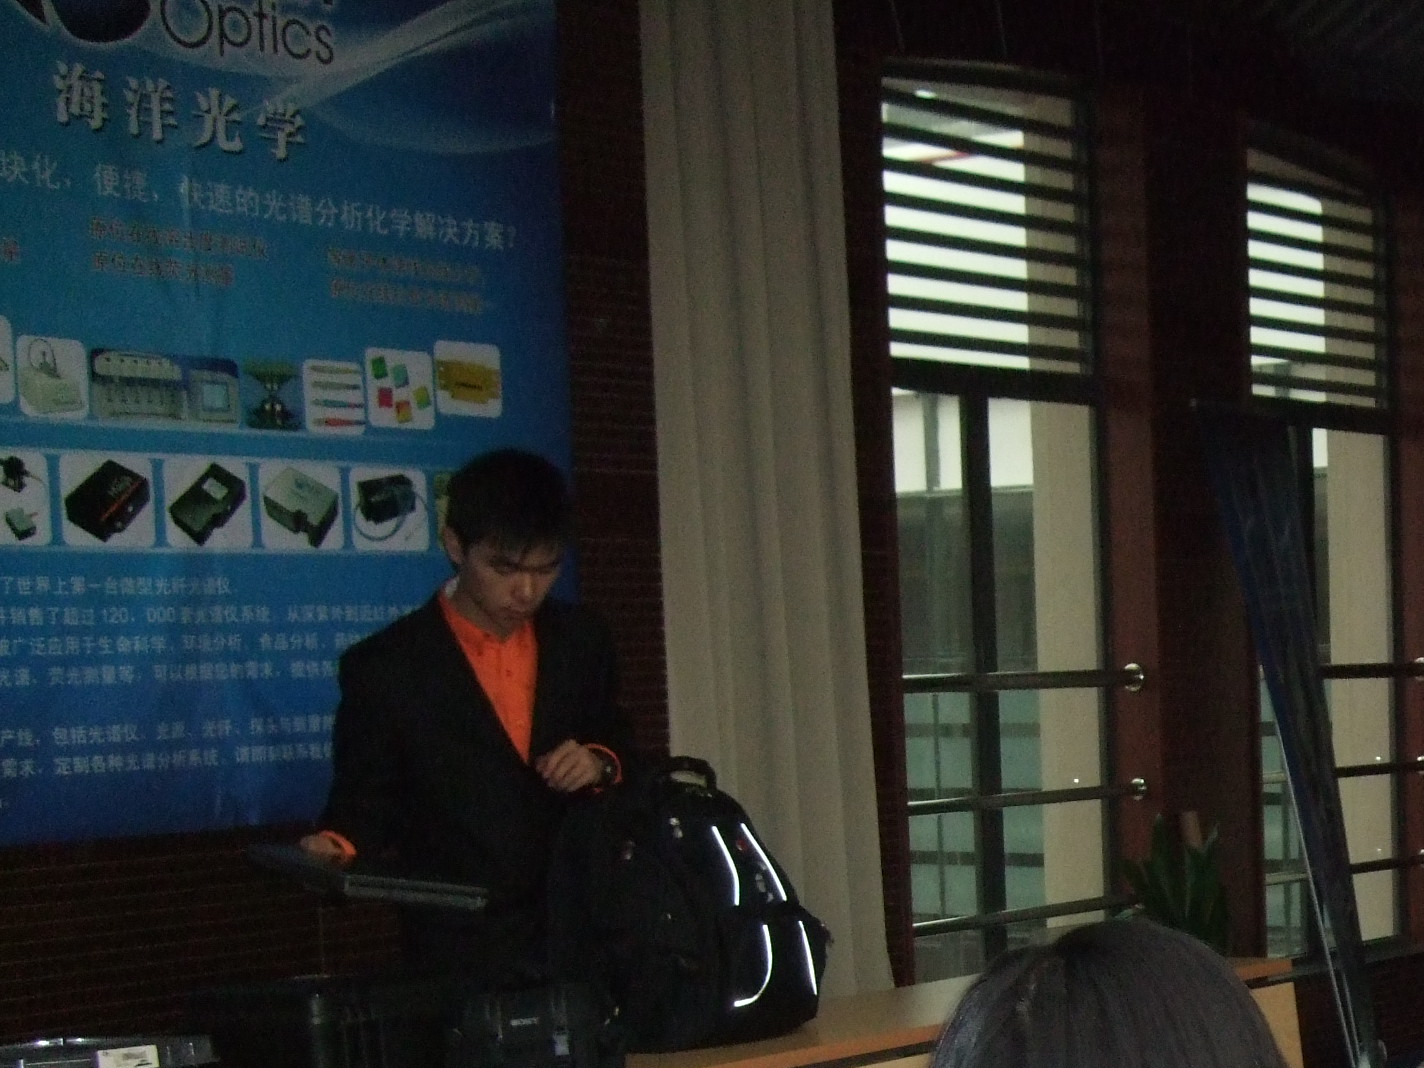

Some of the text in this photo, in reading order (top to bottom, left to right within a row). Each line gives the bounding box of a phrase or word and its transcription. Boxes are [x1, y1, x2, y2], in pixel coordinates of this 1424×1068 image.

[160, 0, 334, 64] Optics
[53, 60, 306, 161] 海洋光学
